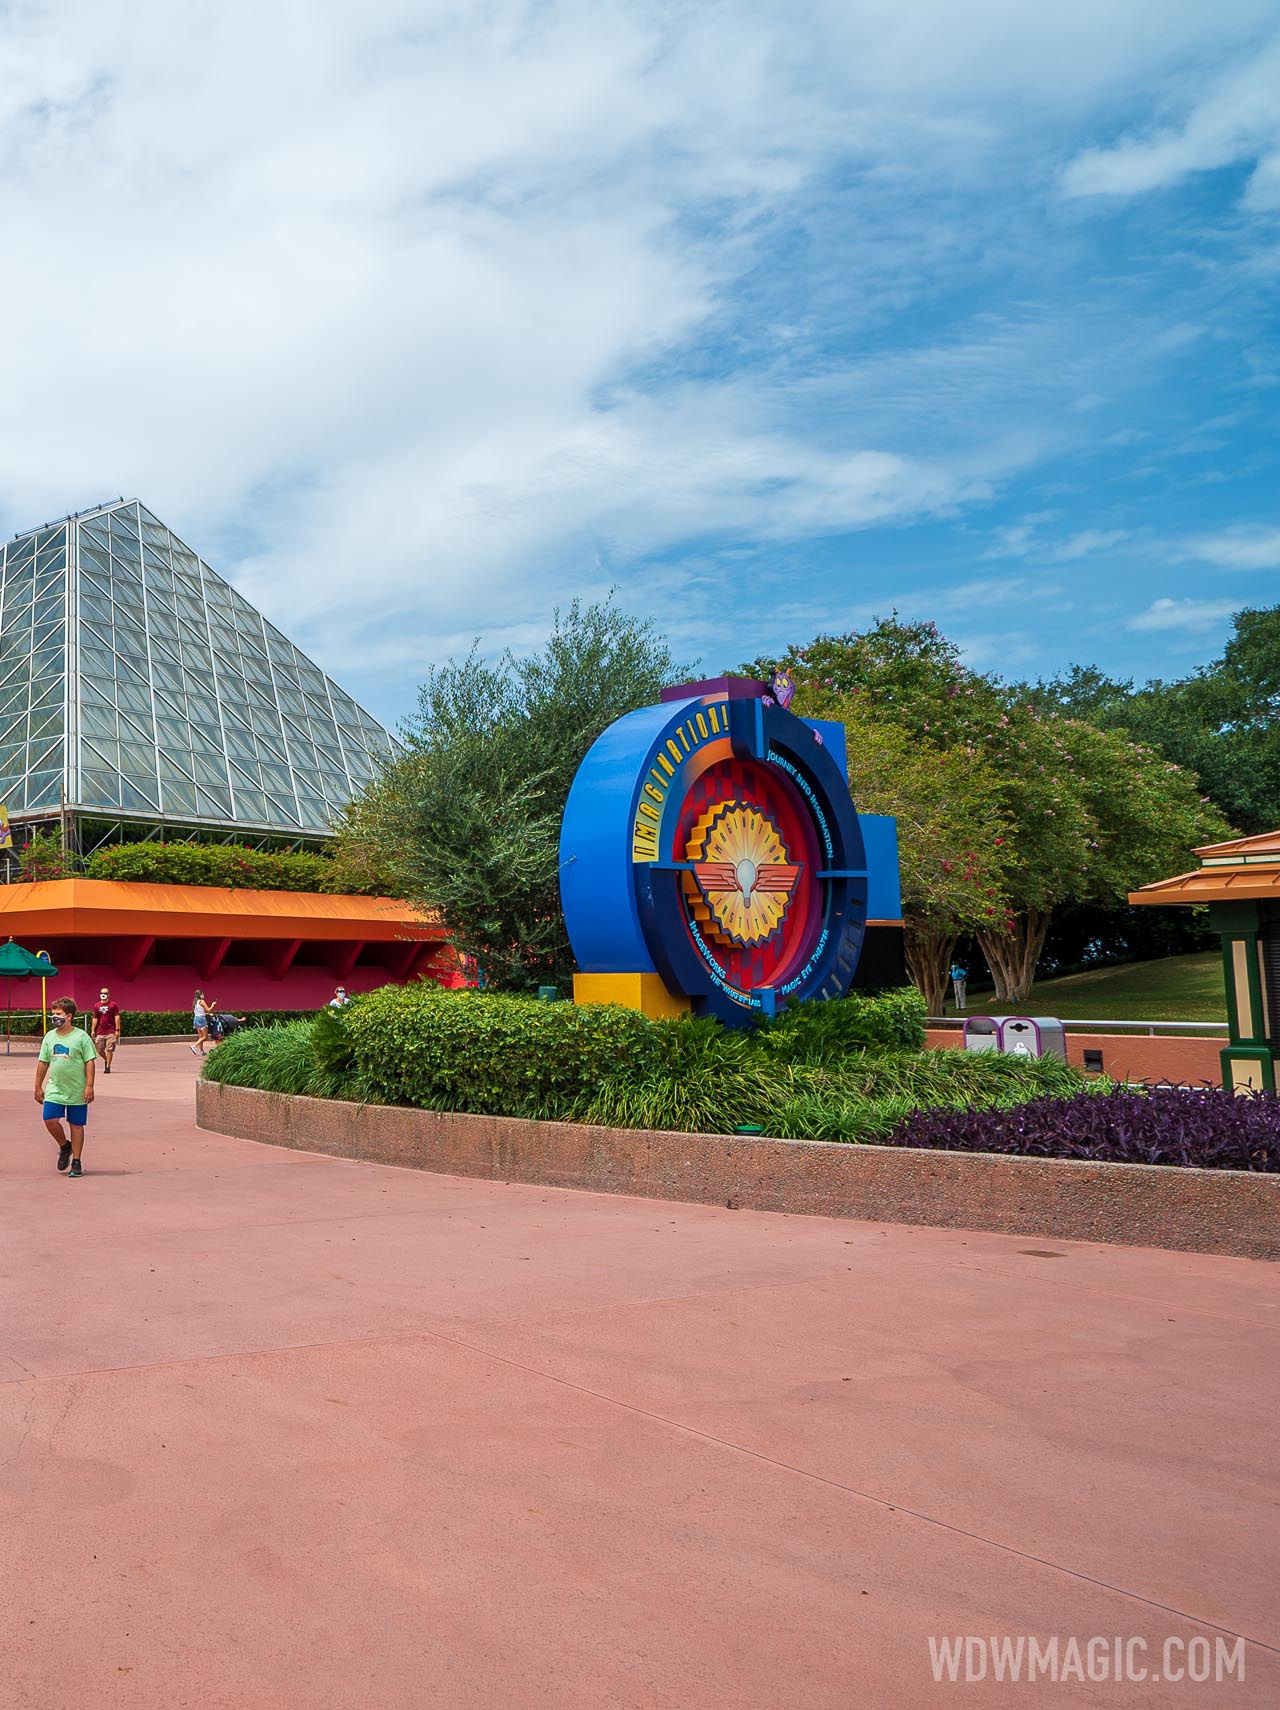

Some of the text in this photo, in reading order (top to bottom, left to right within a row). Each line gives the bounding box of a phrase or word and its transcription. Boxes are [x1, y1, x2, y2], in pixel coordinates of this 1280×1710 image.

[633, 704, 729, 857] IMAGINATION!
[766, 750, 834, 859] JOURNEY INTO IMAGINATION
[689, 920, 727, 979] IMAGEWORKS
[710, 971, 721, 986] THE
[781, 929, 829, 996] MAGIC EYE THEATER
